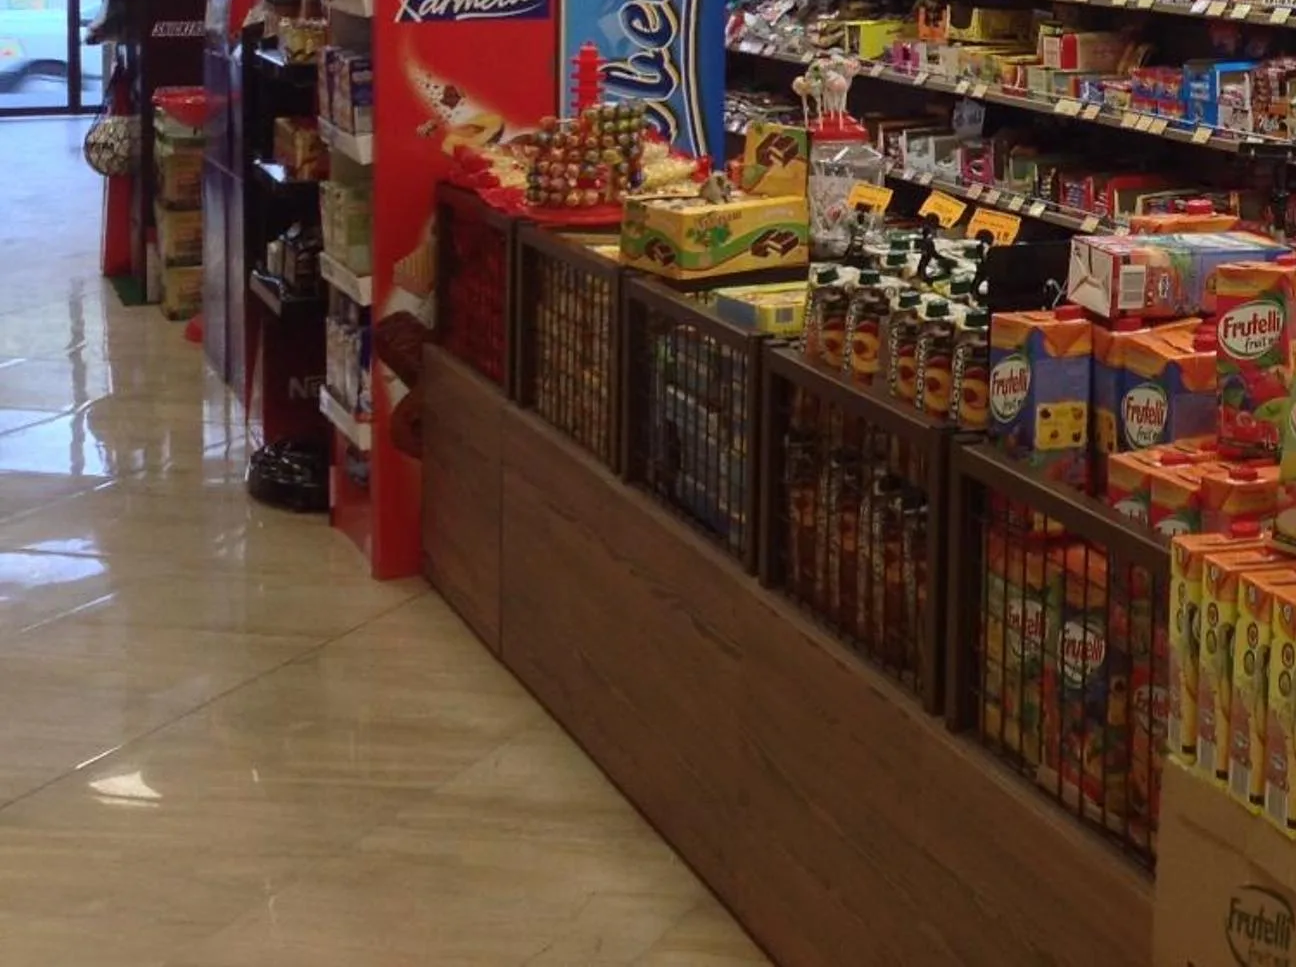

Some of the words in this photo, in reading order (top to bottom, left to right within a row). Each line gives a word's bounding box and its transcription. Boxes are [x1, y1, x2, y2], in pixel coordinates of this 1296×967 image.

[1222, 308, 1284, 341] Frutelli
[992, 363, 1031, 397] Frutelli
[1126, 397, 1167, 428] Frutelli
